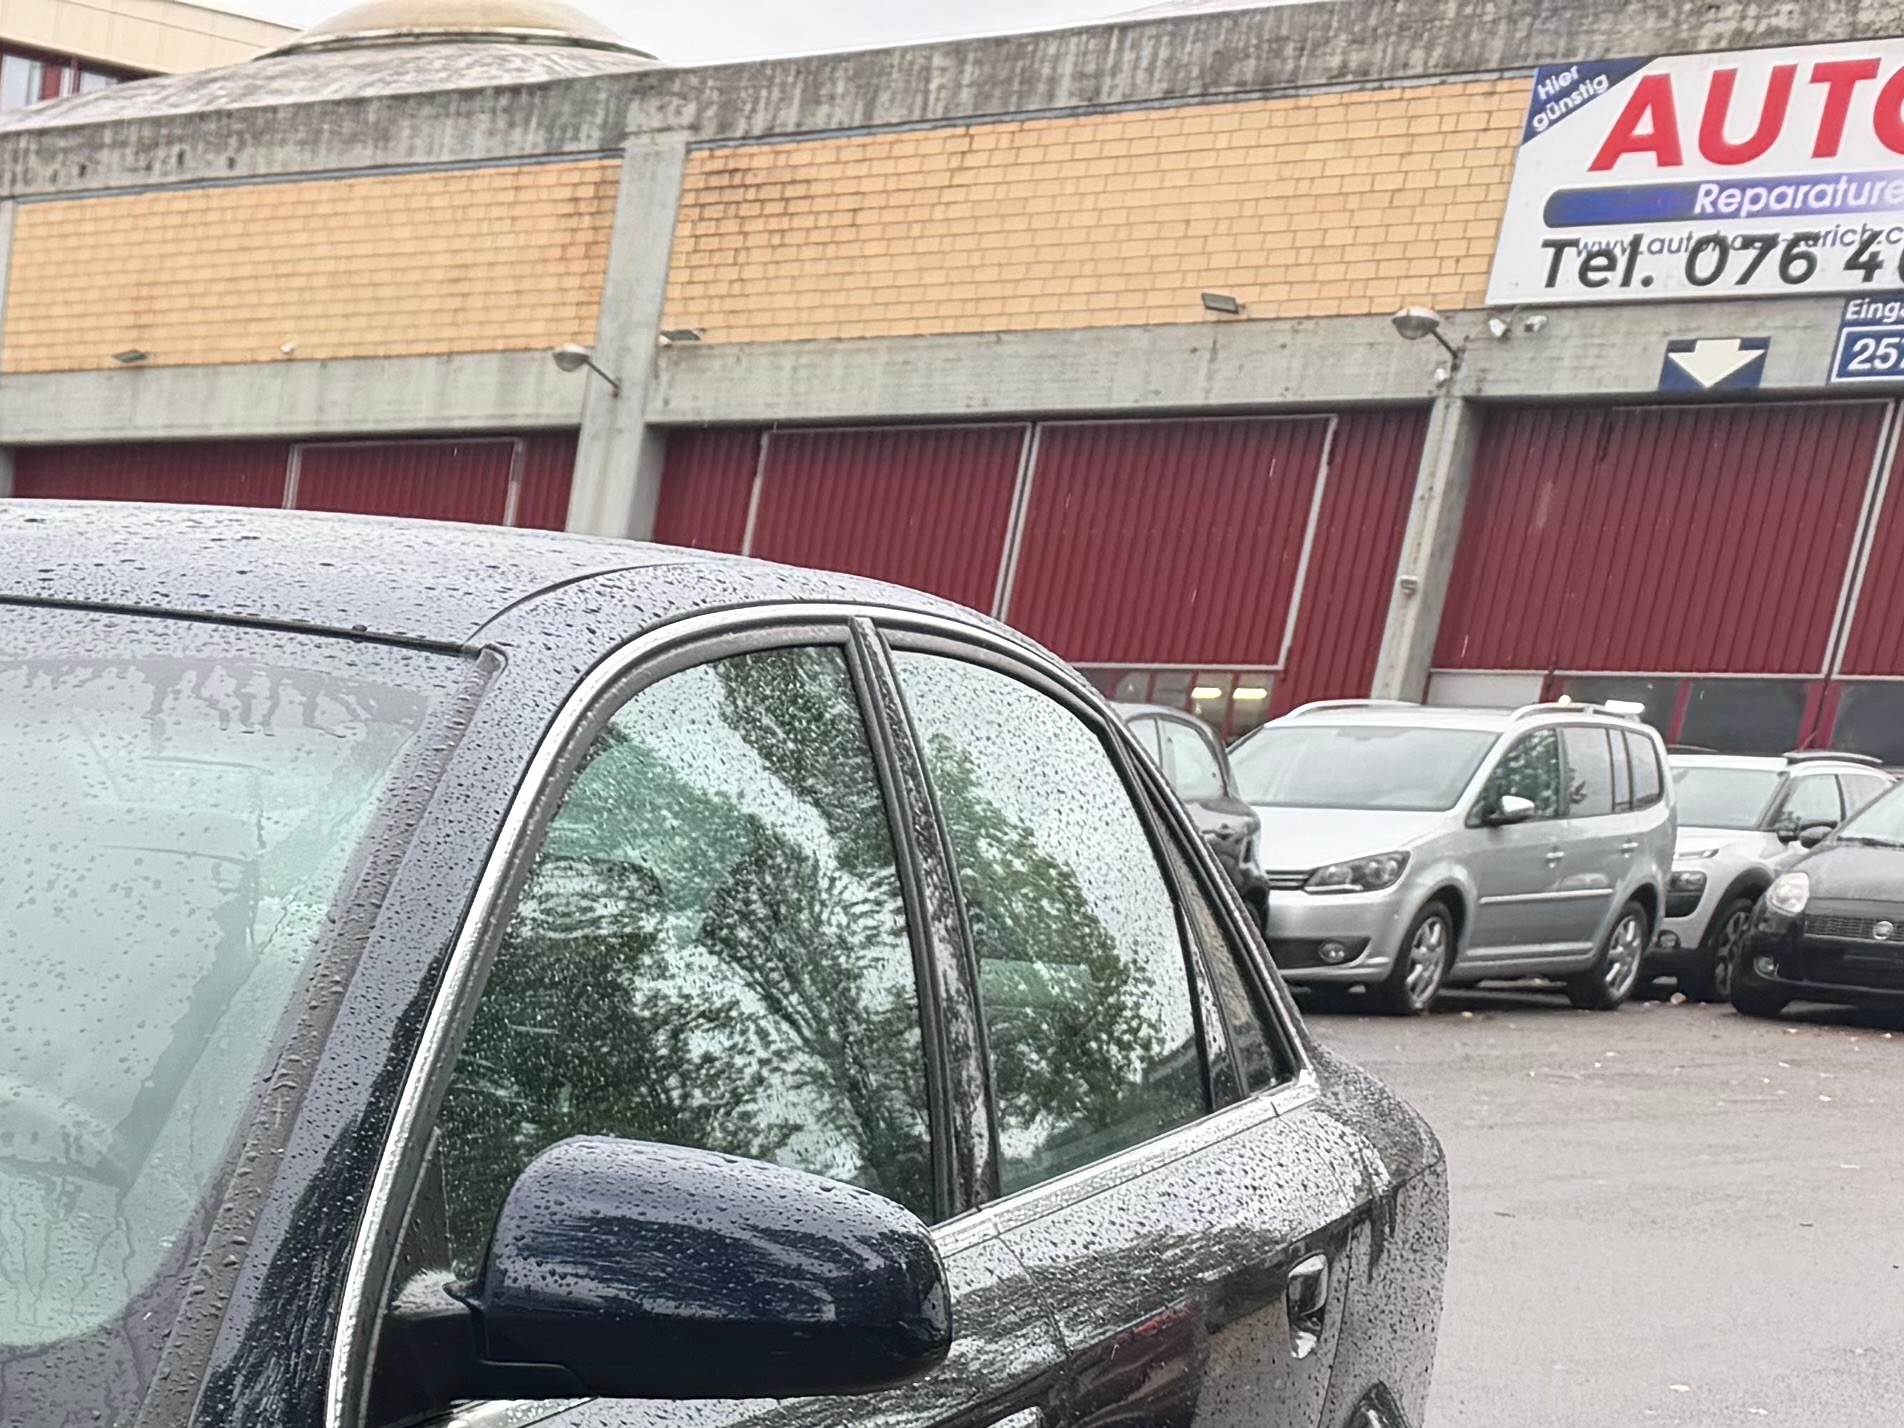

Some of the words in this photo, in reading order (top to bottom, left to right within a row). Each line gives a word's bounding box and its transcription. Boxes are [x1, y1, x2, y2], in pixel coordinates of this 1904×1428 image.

[1533, 74, 1609, 132] günstig
[1537, 65, 1579, 100] Hier
[1541, 233, 1654, 288] Tel.
[1685, 233, 1819, 286] 076
[1842, 229, 1904, 284] 4
